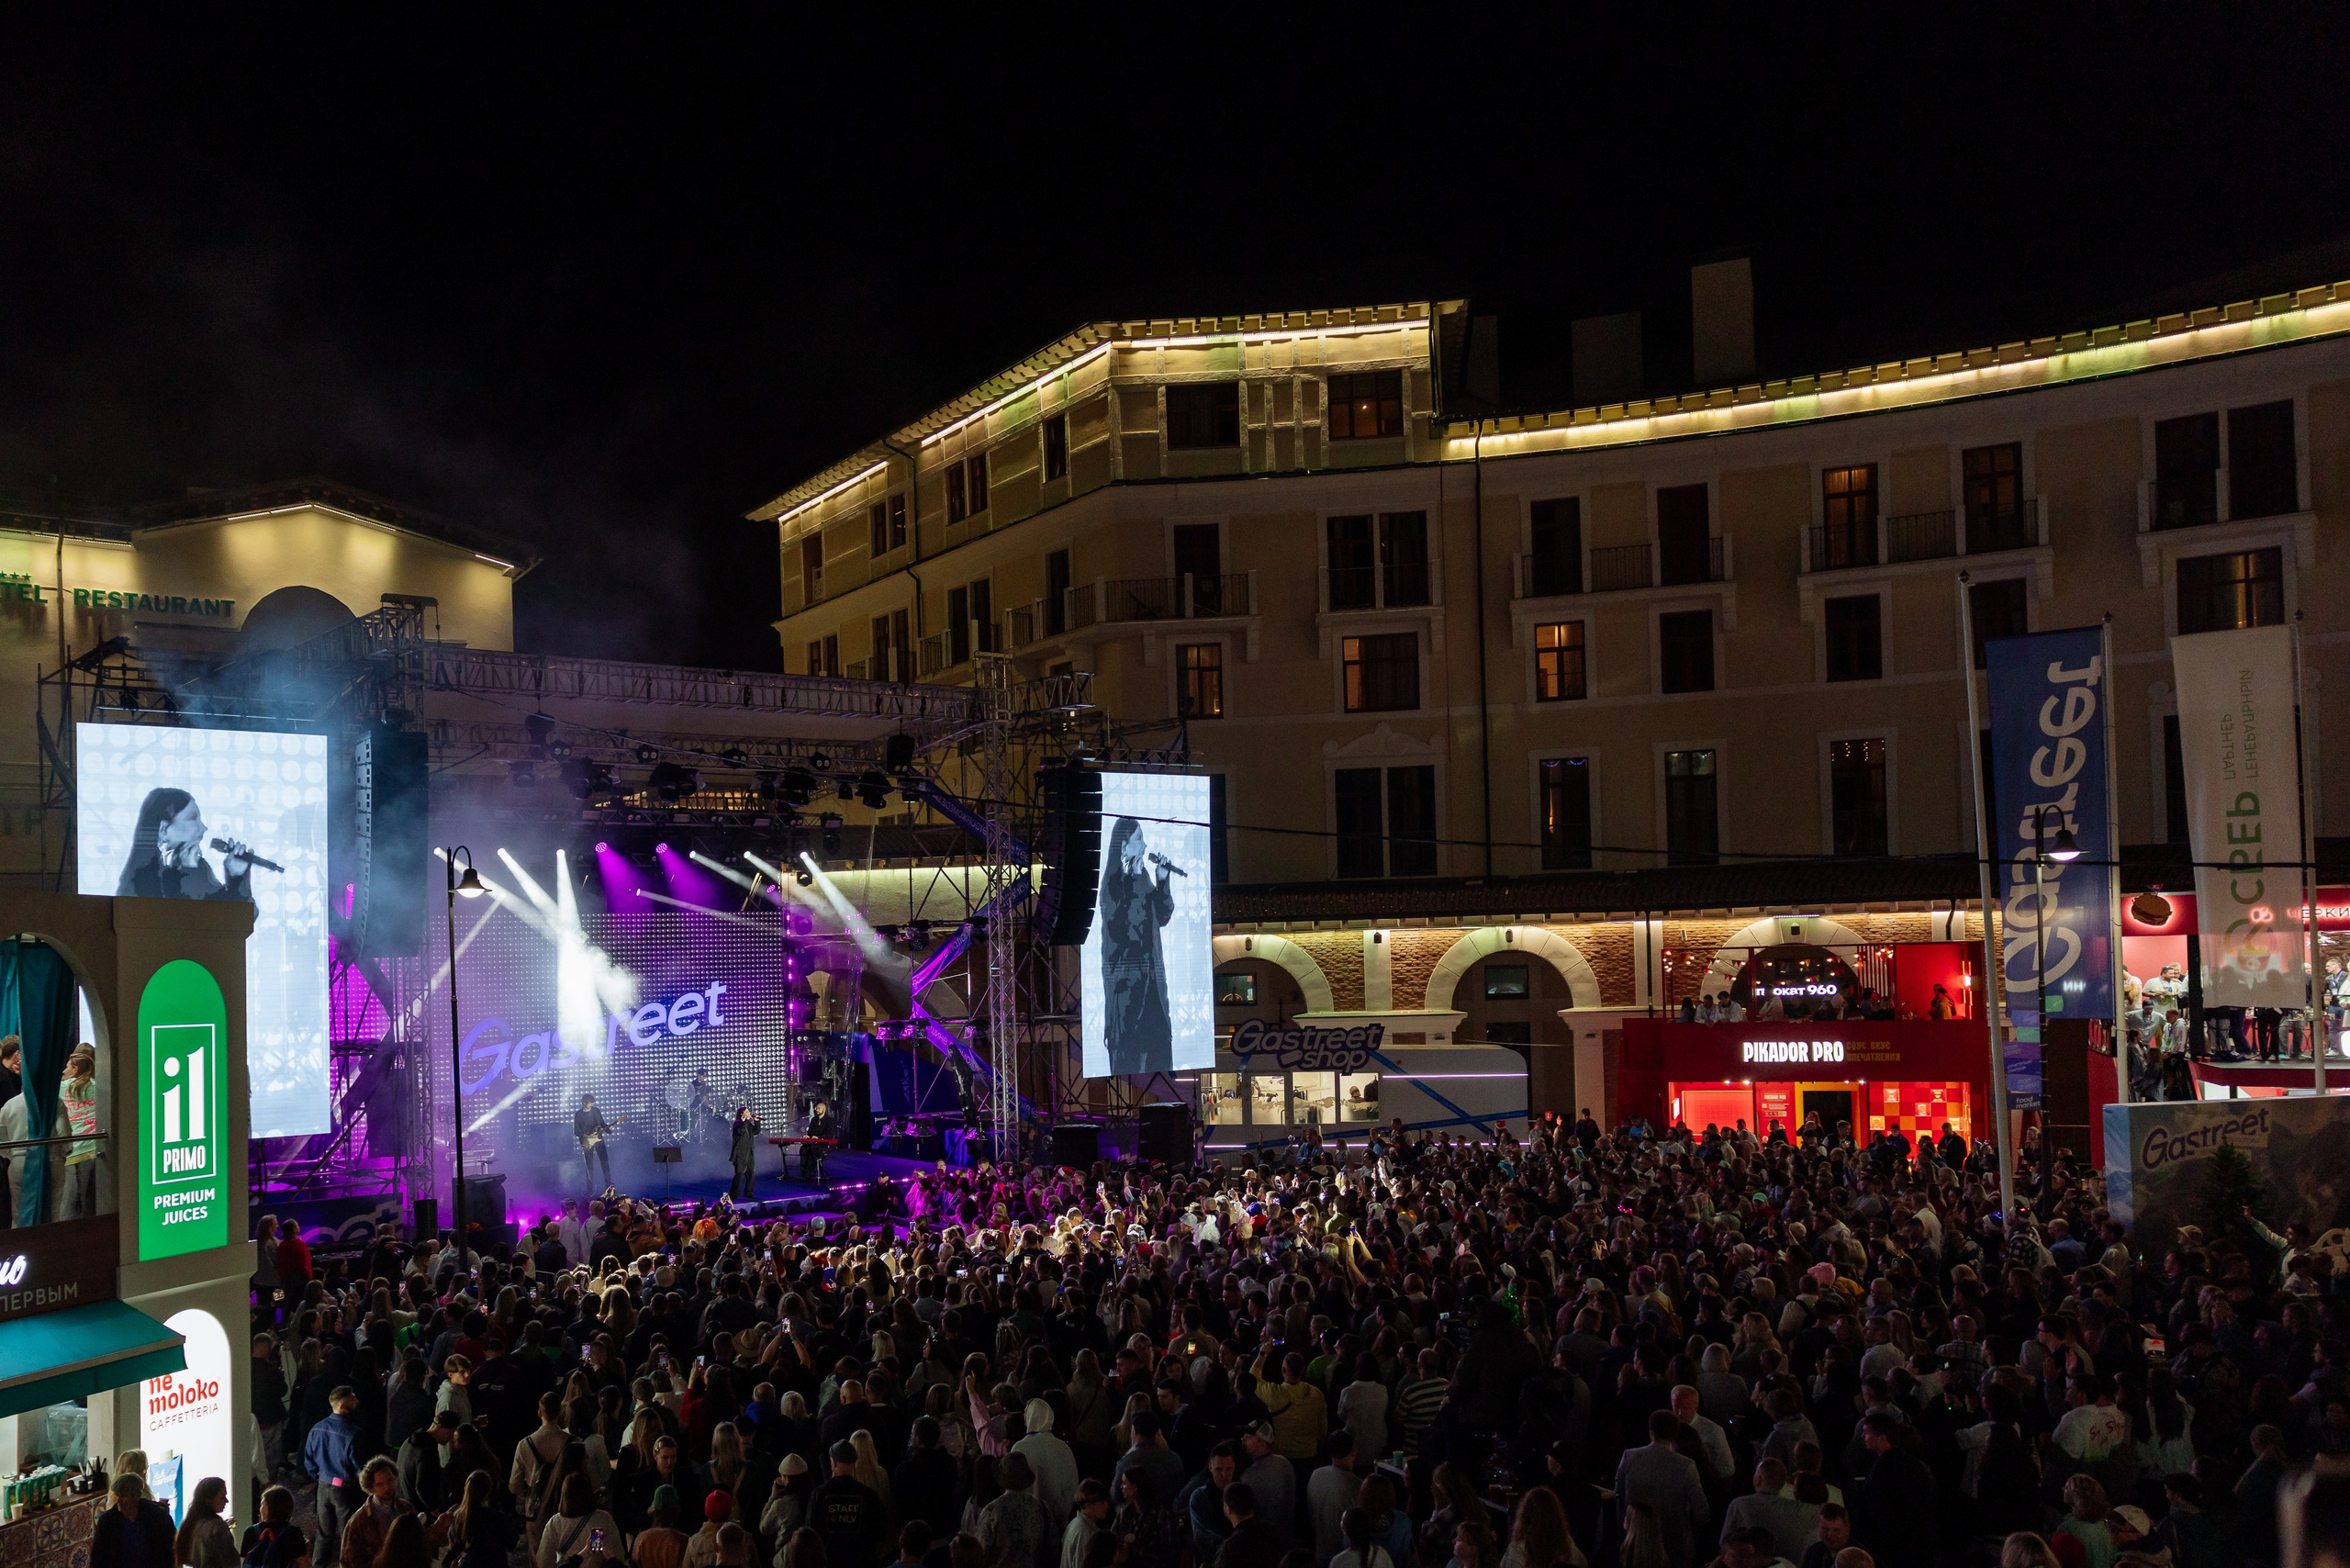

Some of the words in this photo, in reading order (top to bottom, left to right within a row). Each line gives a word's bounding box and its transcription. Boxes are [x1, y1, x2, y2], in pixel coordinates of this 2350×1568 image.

[73, 588, 236, 618] RESTAURANT
[1756, 986, 1806, 997] покат
[1807, 984, 1838, 996] 960
[452, 980, 727, 1096] Gastreet
[1232, 1019, 1382, 1054] Gastreet
[1301, 1044, 1368, 1074] shop
[1742, 1041, 1809, 1063] PIKADOR
[1811, 1040, 1844, 1063] PRO
[162, 1046, 207, 1144] il
[2142, 1107, 2270, 1170] Gastreet
[162, 1145, 207, 1174] PRIMO
[153, 1187, 216, 1210] PREMIUM
[162, 1205, 208, 1226] JUICES
[149, 1373, 173, 1395] ne
[149, 1378, 219, 1415] moloko
[149, 1403, 219, 1432] CAFFETTERIA
[828, 1504, 860, 1513] STAFF
